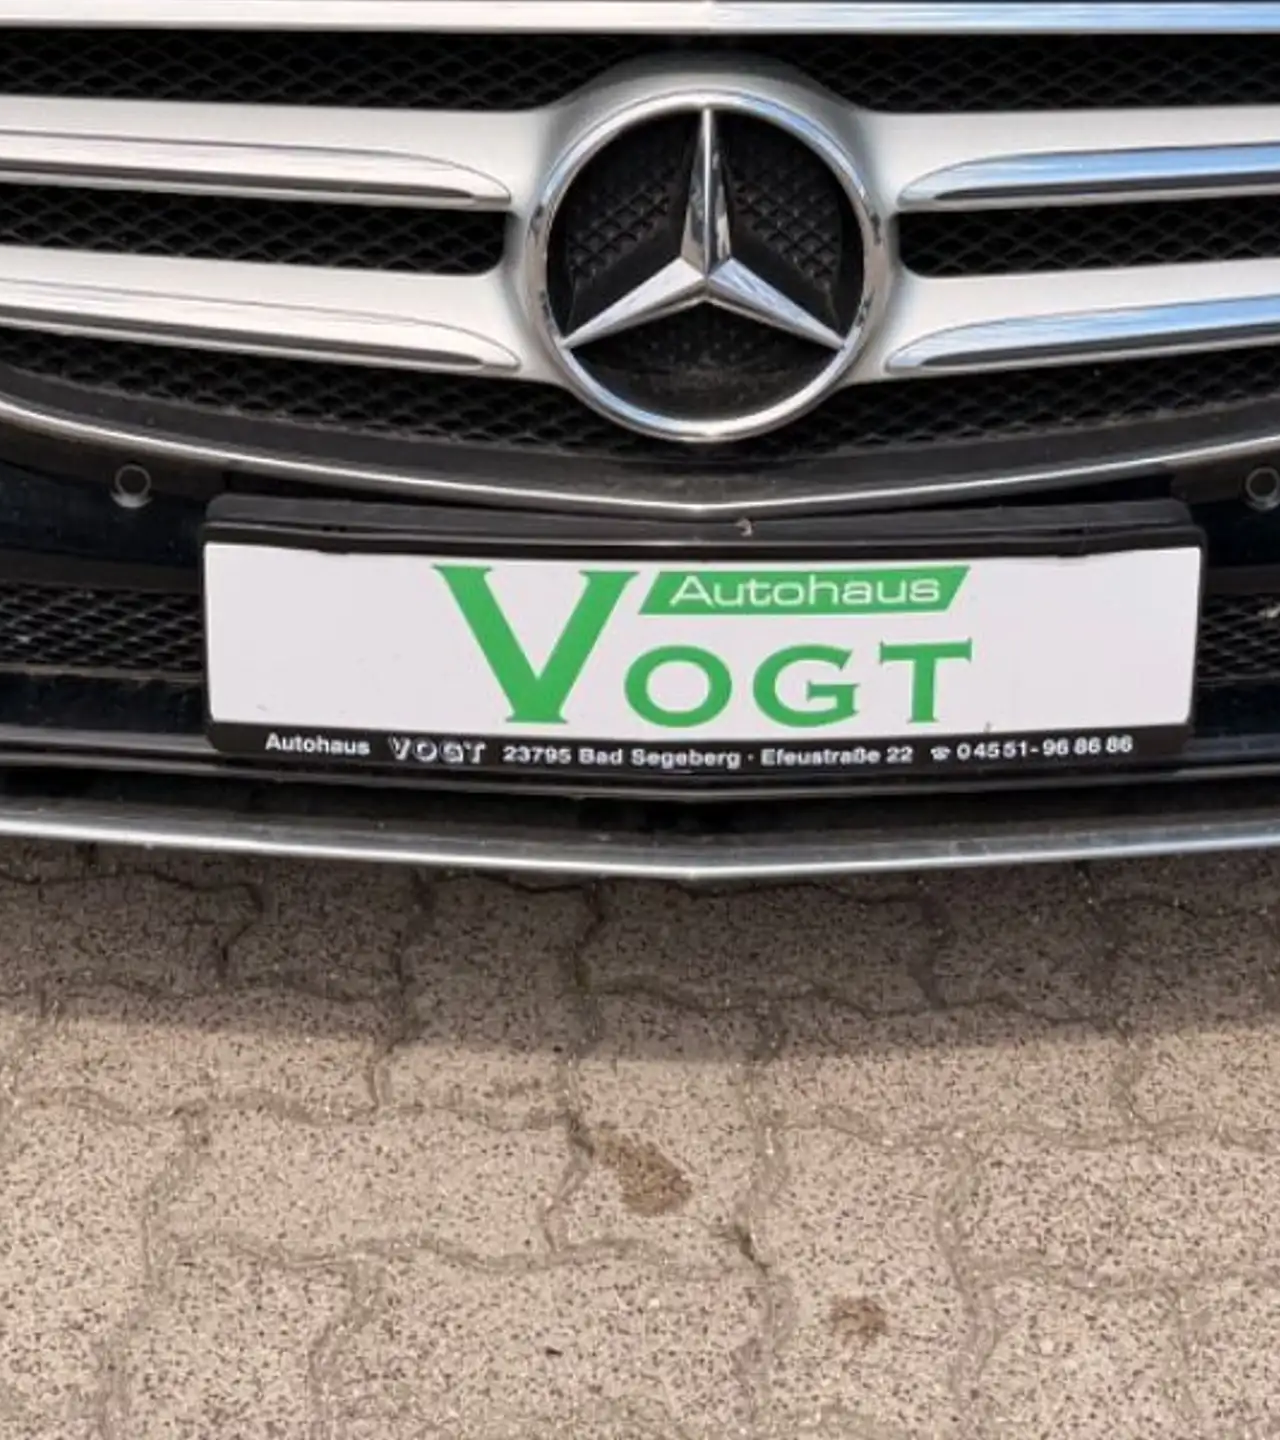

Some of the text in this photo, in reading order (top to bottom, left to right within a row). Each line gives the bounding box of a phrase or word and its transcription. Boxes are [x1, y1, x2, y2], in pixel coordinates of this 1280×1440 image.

[669, 572, 943, 608] Autohaus
[431, 563, 973, 728] VOGT
[264, 732, 370, 756] Autohaus
[388, 737, 488, 764] VOGT
[503, 745, 573, 765] 23795
[578, 747, 624, 766] Bad
[631, 746, 742, 770] Segeberg
[760, 746, 880, 767] Efeustraße
[886, 747, 914, 764] 22
[1073, 739, 1102, 757] 86
[1106, 736, 1134, 754] 86
